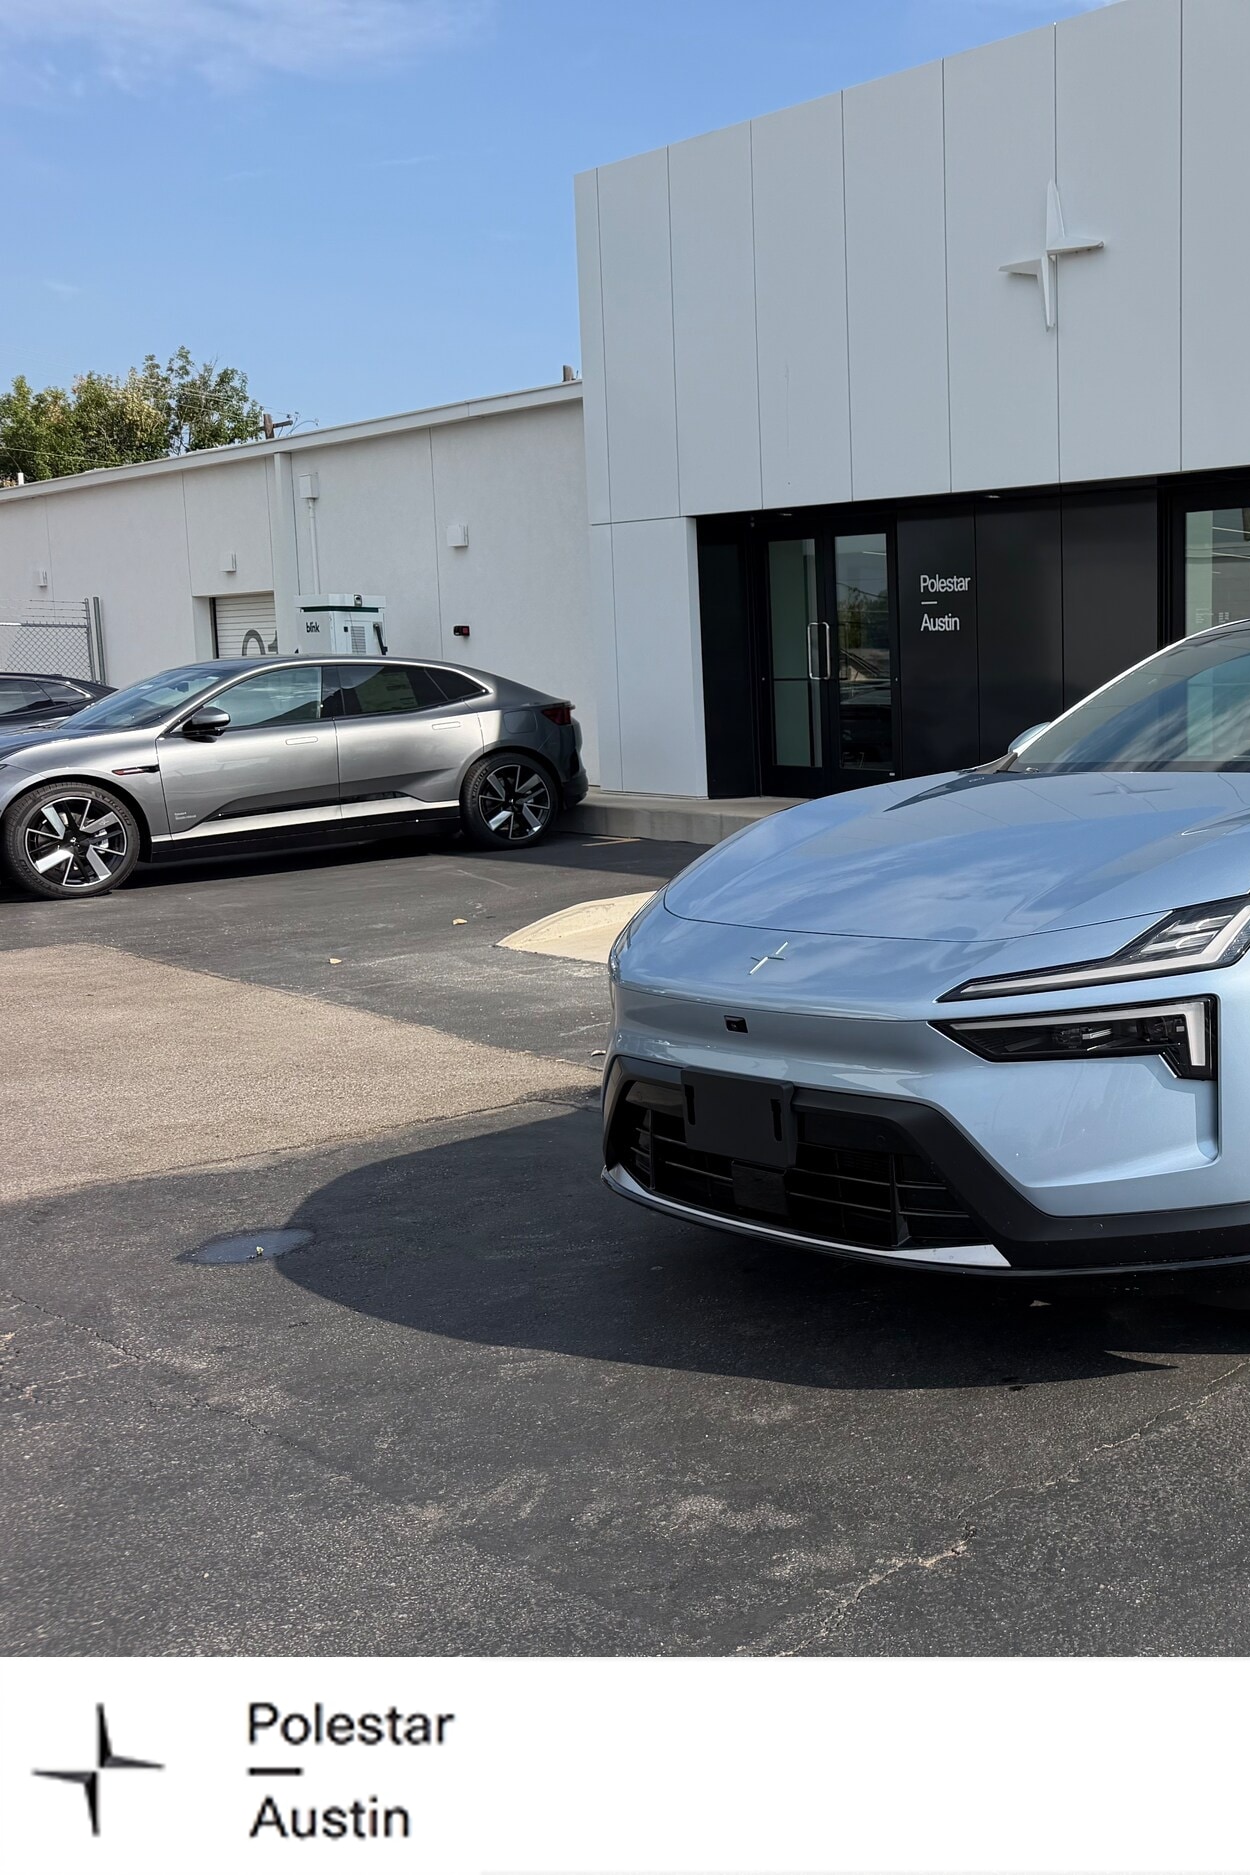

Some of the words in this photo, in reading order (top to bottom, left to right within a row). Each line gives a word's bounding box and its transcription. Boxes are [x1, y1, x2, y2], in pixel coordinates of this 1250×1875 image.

[921, 574, 970, 592] Polestar
[306, 621, 320, 633] blink
[921, 614, 959, 631] Austin
